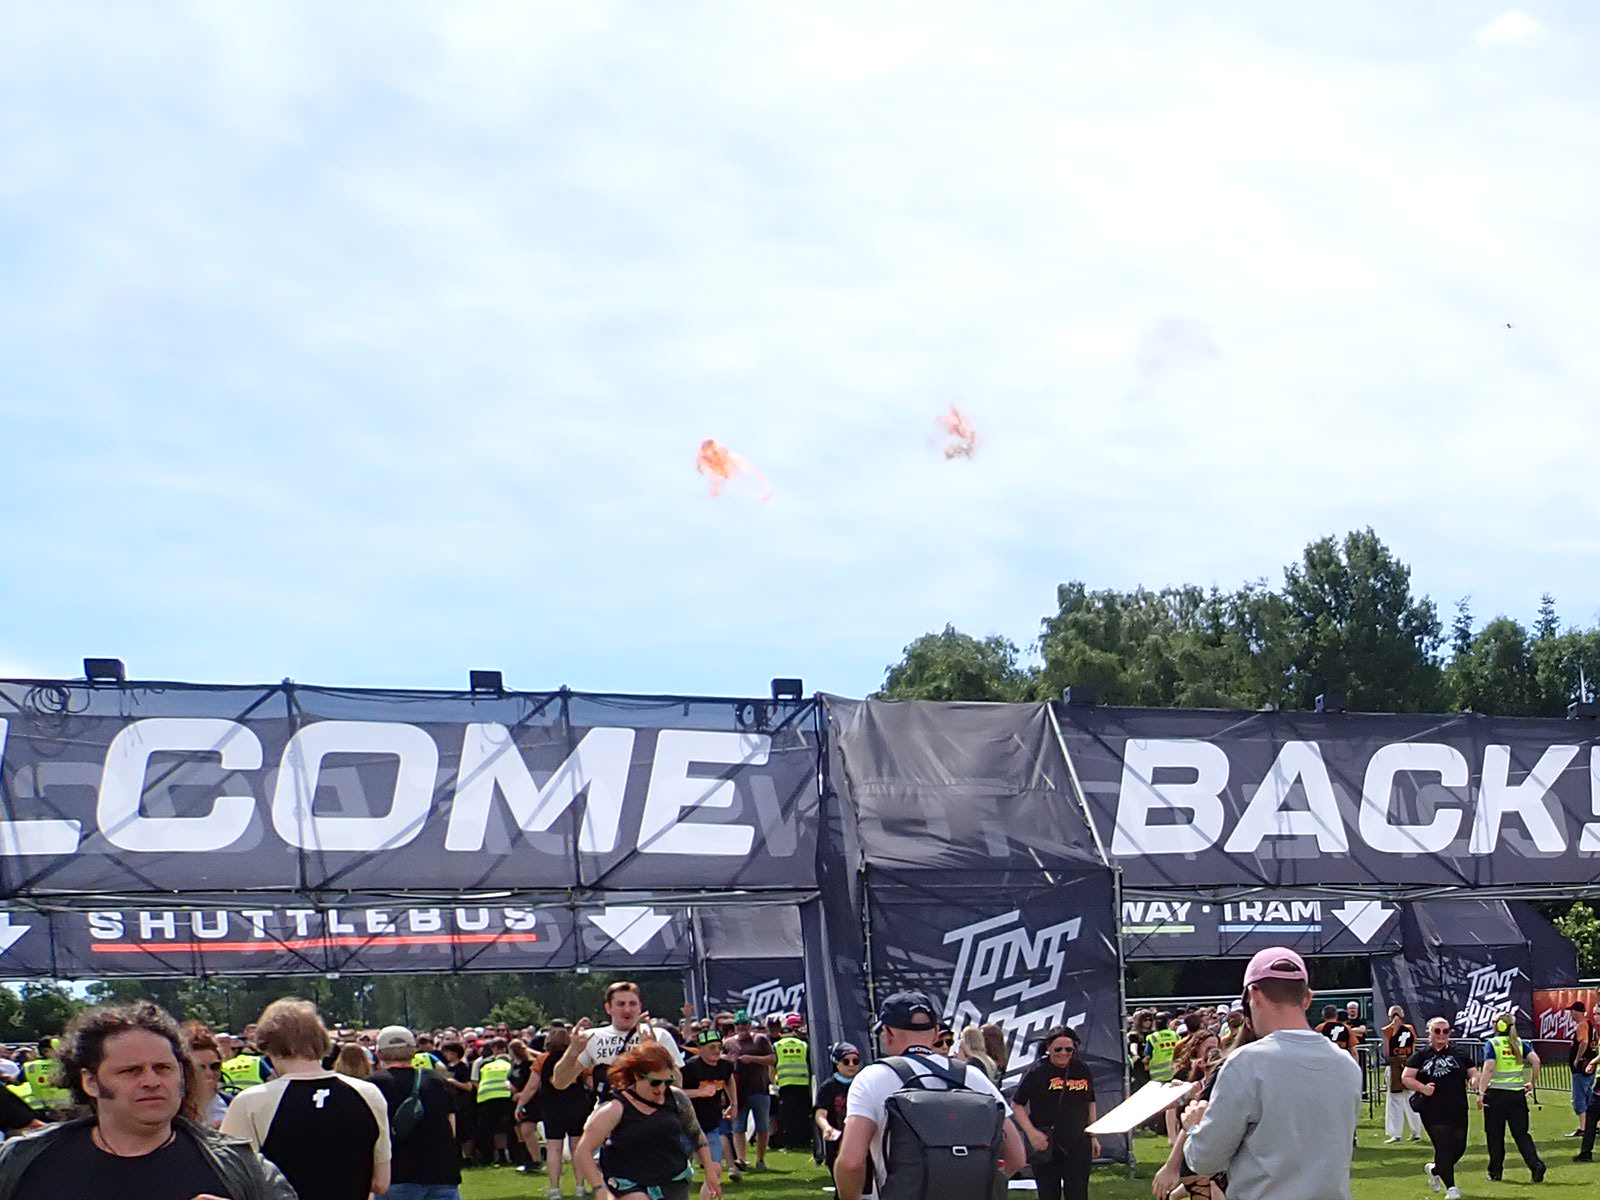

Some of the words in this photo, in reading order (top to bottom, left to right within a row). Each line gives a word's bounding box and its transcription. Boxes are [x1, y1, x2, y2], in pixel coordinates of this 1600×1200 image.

[88, 907, 537, 940] SHUTTLEBUS
[943, 909, 1082, 1019] TONS
[1466, 963, 1519, 1007] TONS
[596, 1036, 641, 1046] AVENGE
